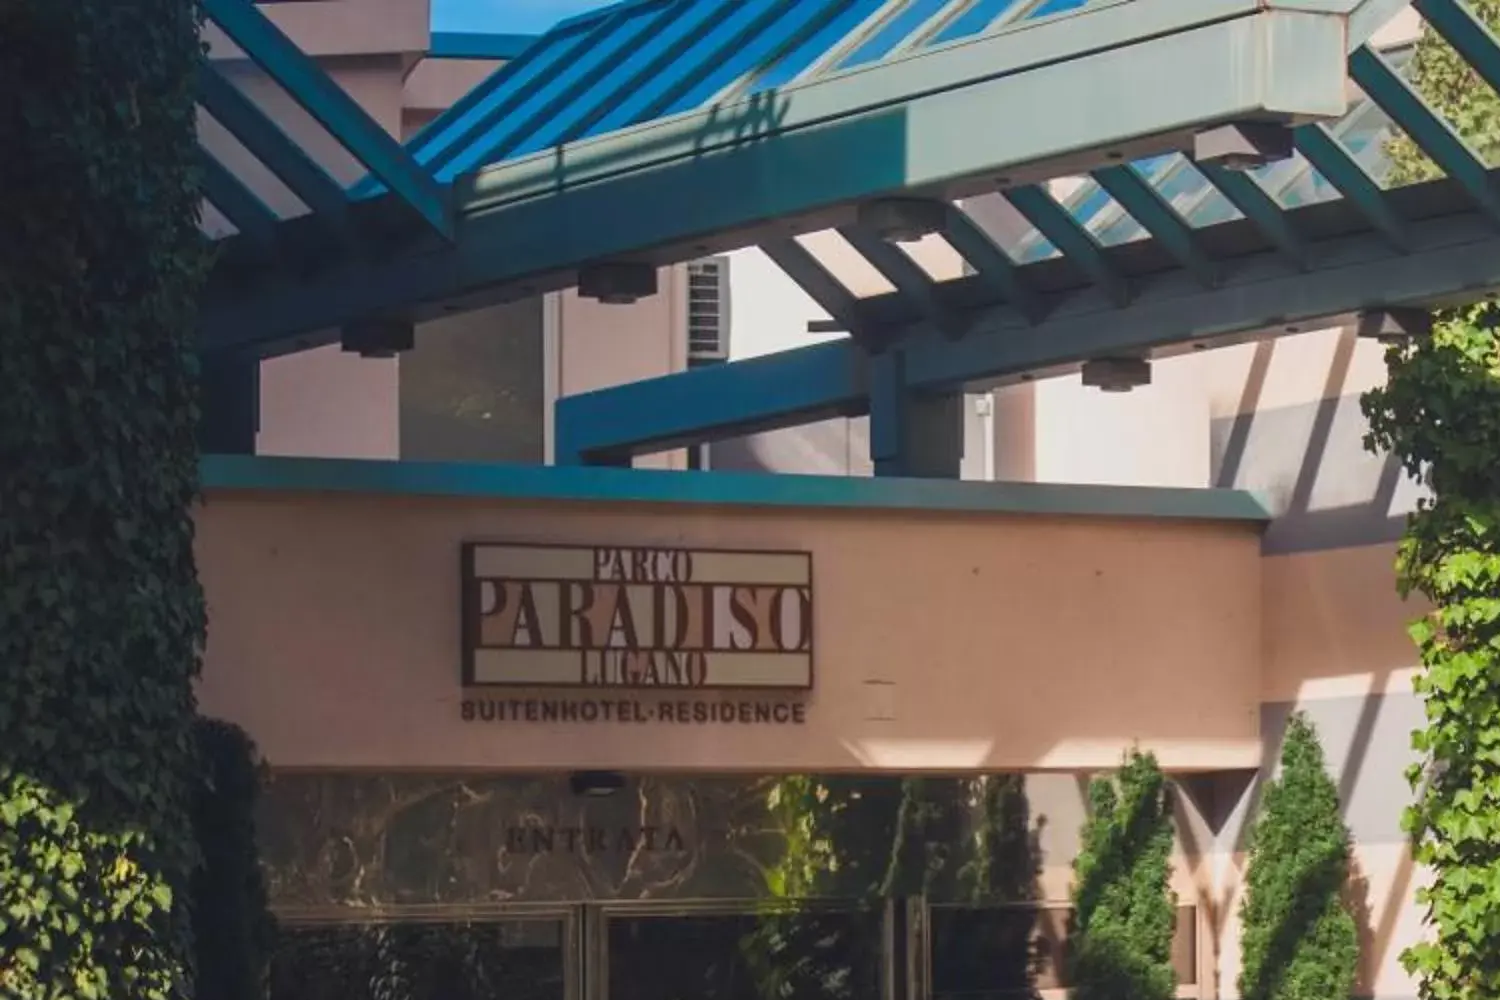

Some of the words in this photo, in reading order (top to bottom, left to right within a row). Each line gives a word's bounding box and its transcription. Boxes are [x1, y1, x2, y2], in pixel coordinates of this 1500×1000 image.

[594, 546, 694, 584] PARCO
[470, 579, 811, 652] PARADISO
[581, 649, 707, 687] LUGANO
[505, 825, 685, 854] ENTRATA
